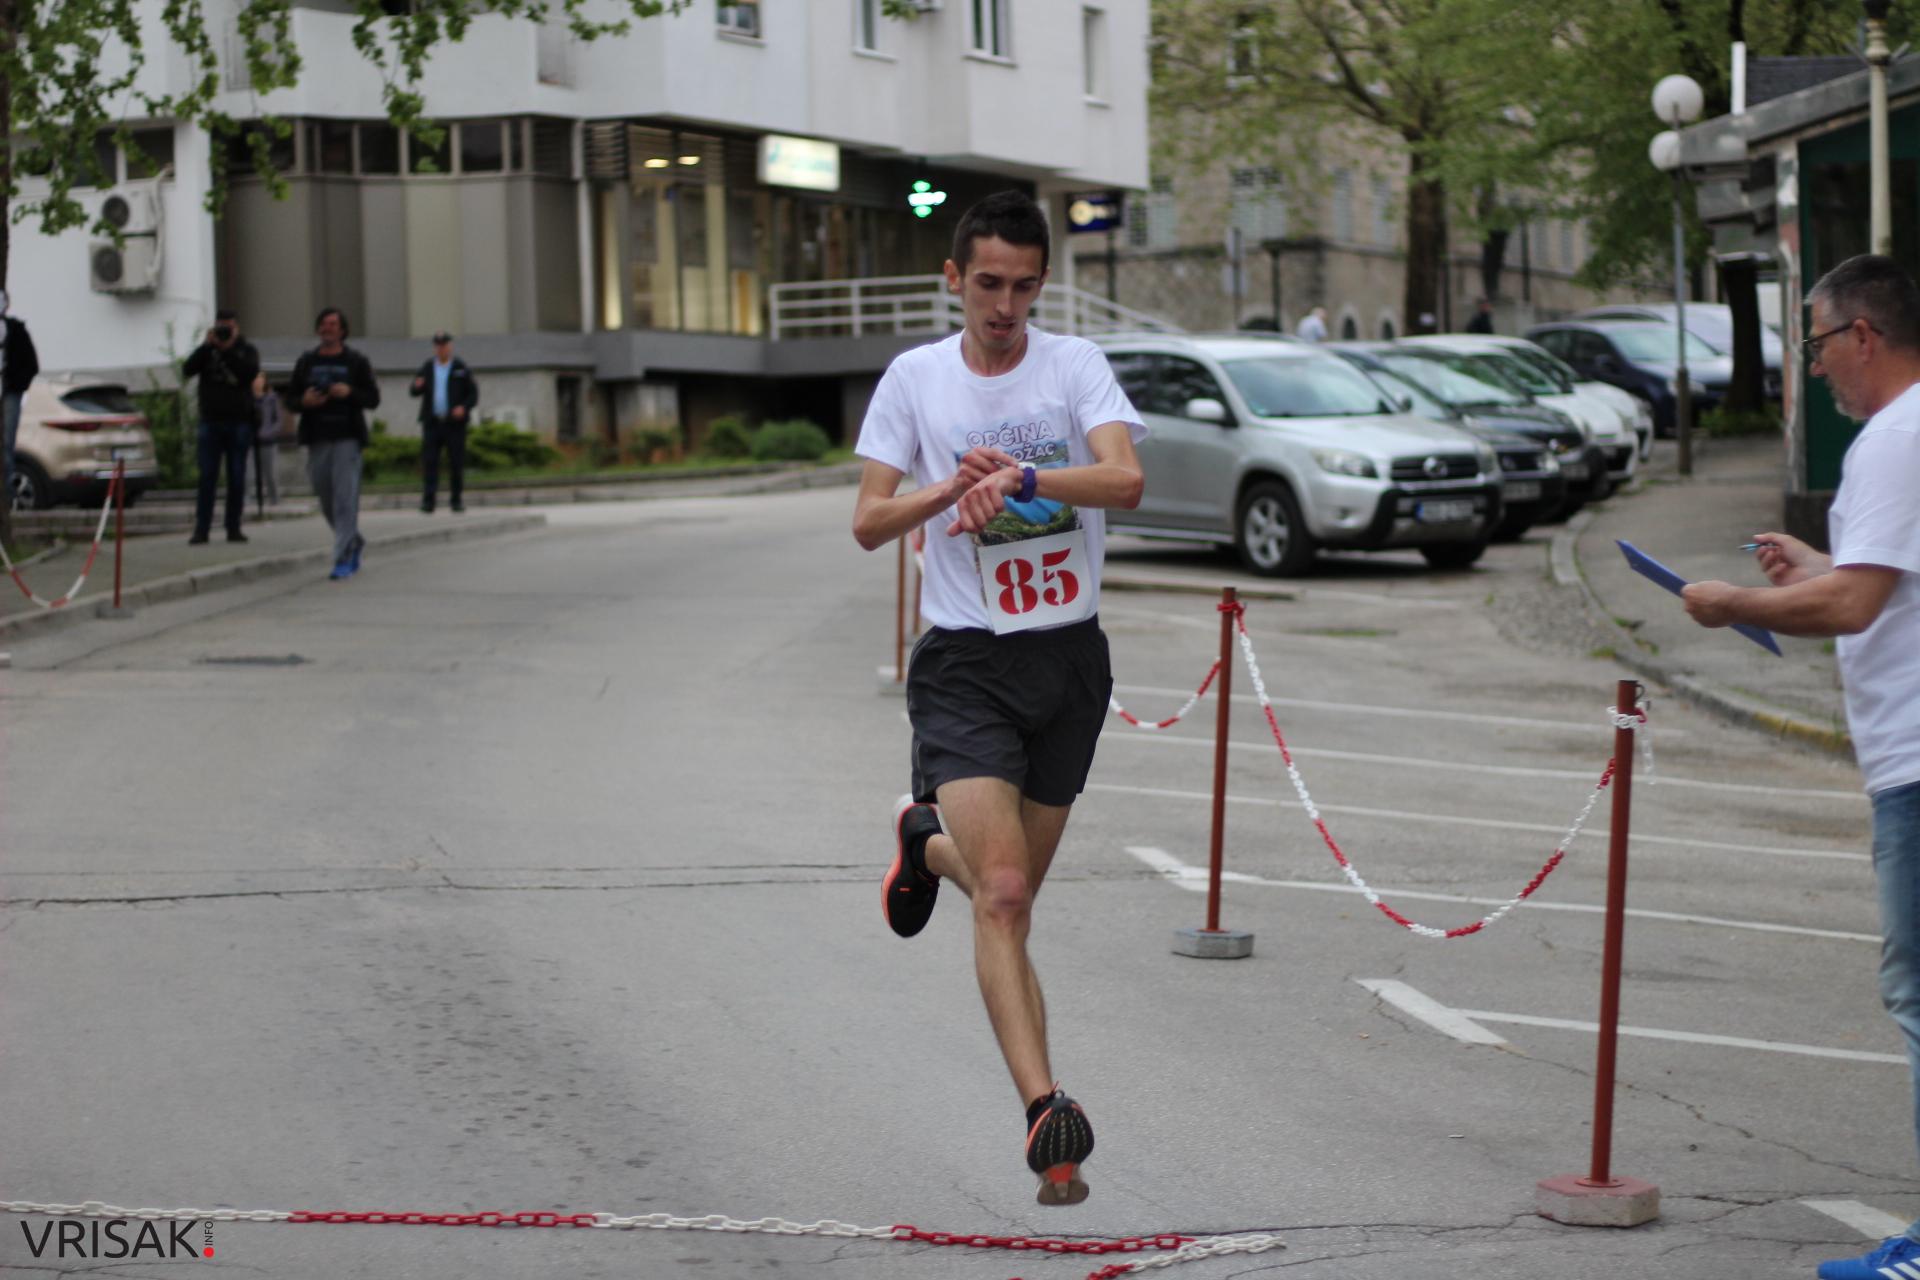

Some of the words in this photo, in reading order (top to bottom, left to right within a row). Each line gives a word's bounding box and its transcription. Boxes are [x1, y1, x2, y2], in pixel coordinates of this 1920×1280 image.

[966, 420, 1055, 449] OPĆINA
[1011, 442, 1057, 462] OŽAC
[994, 547, 1079, 615] 85
